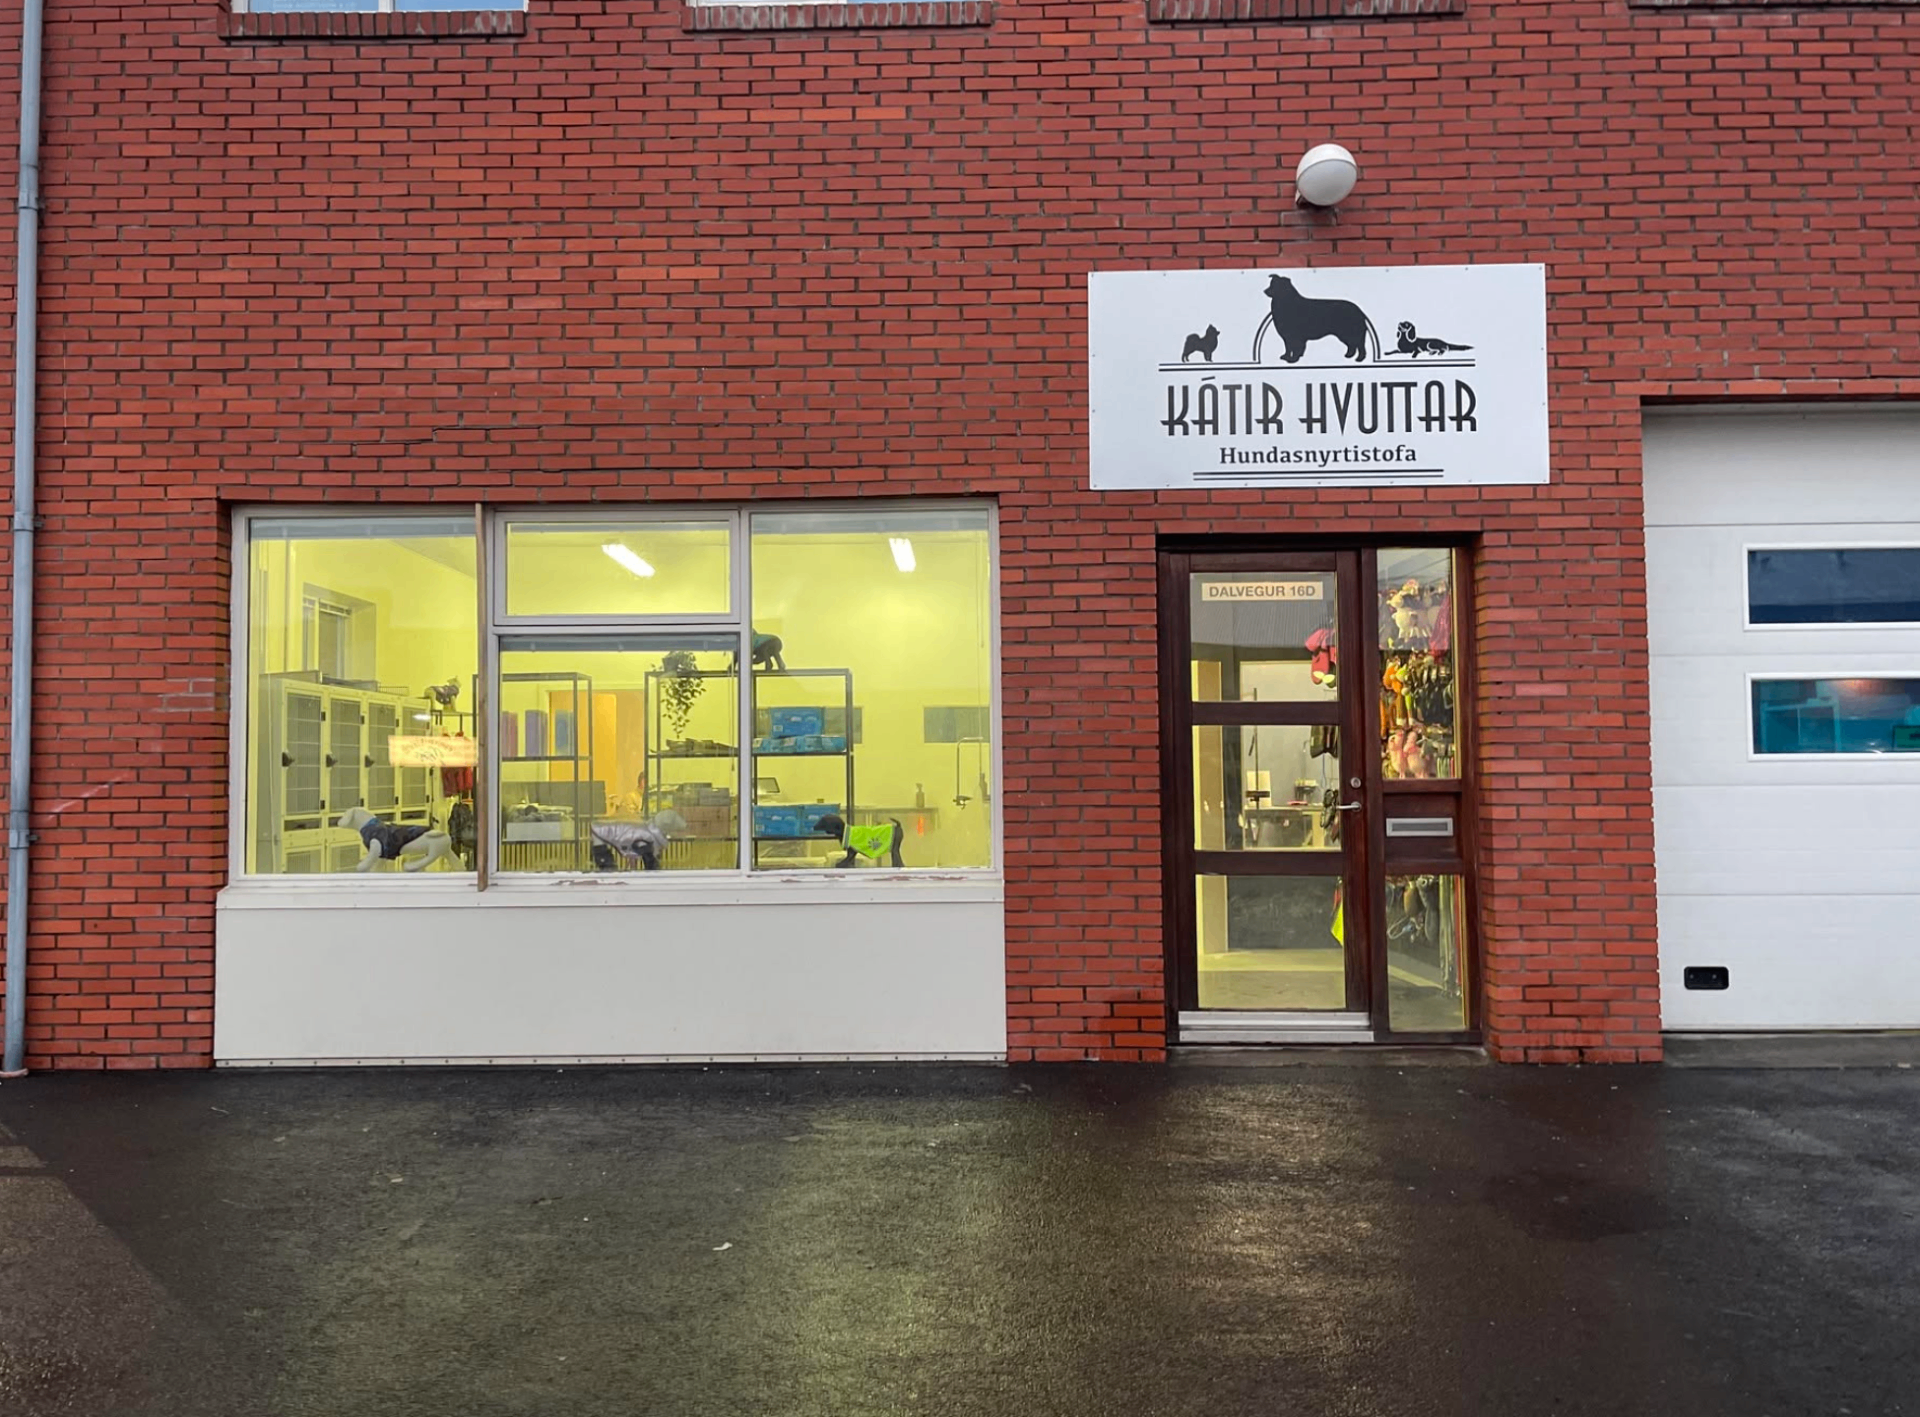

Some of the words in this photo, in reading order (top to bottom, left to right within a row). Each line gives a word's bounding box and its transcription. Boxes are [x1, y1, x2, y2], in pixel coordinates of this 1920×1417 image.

[1160, 376, 1283, 436] KÁTIR
[1298, 379, 1477, 435] HVUTTAR
[1219, 445, 1417, 467] Hundasnyrtistofa
[1209, 585, 1286, 598] DALVEGUR
[1290, 585, 1316, 597] 16D
